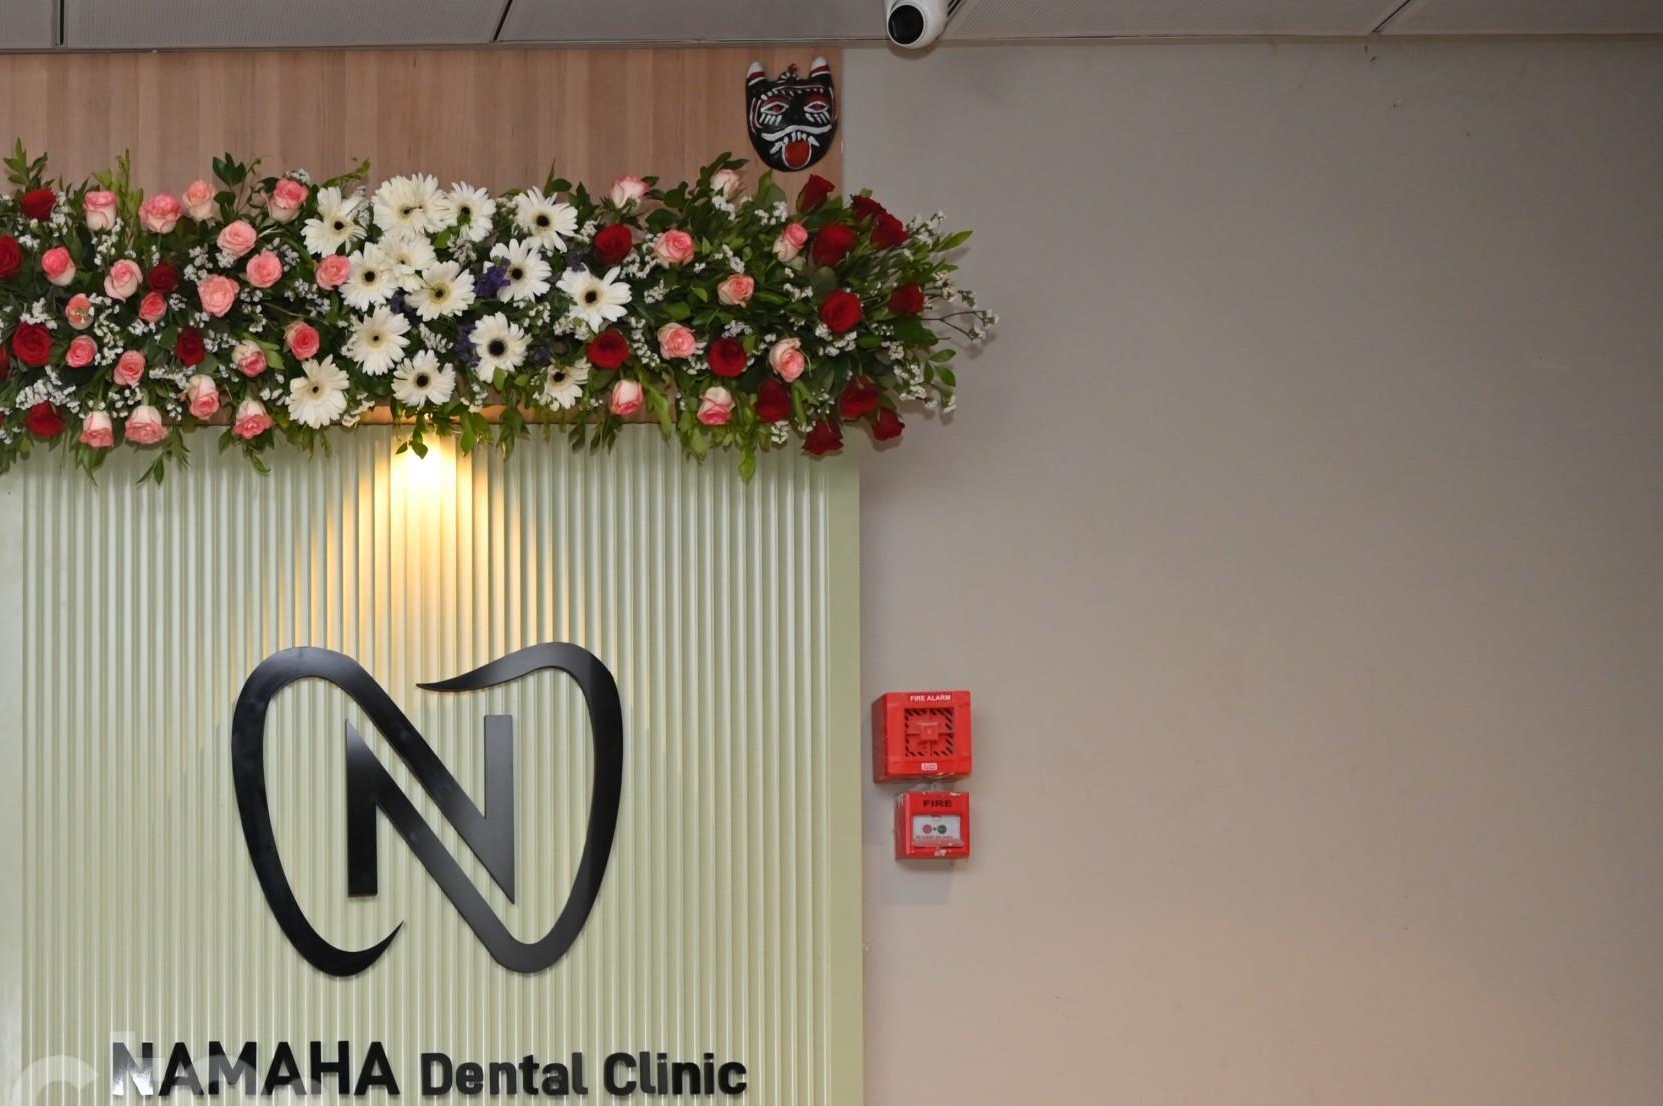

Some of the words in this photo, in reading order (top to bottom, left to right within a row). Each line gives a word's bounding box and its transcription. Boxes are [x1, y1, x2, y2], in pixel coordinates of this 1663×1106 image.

[927, 694, 951, 702] ALARM
[923, 799, 953, 807] FIRE
[111, 1040, 401, 1098] NAMAHA
[420, 1052, 588, 1098] Dental
[603, 1051, 748, 1097] Clinic
